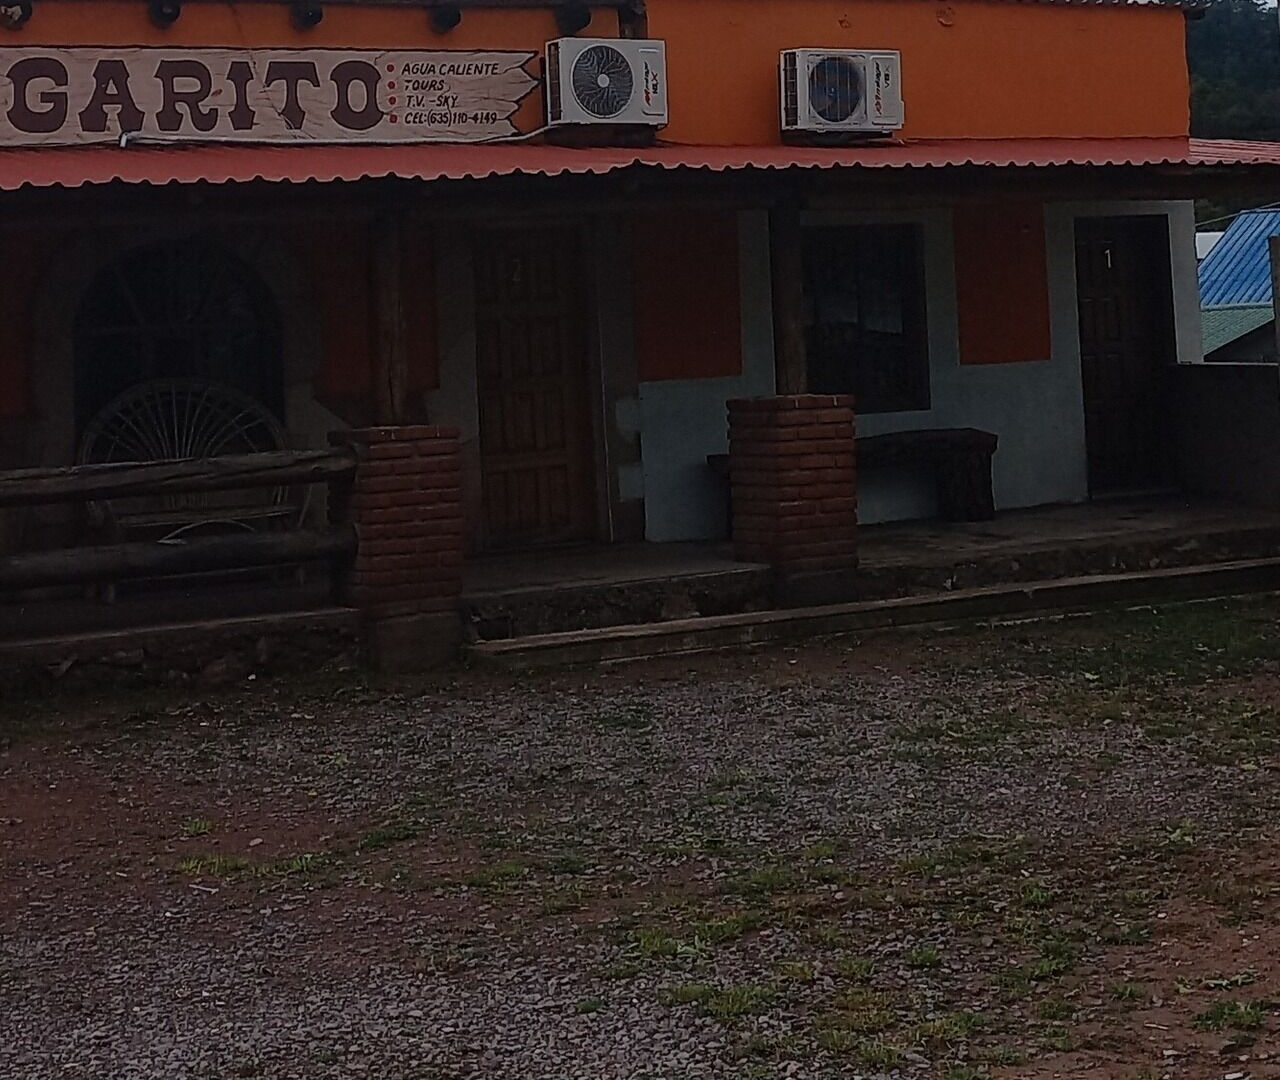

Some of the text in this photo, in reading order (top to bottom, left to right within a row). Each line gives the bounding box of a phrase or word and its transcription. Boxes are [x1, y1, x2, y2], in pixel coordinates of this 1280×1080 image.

[401, 62, 500, 76] AGUA CALIENTE
[404, 79, 445, 91] TOURS
[405, 95, 425, 108] T.V.
[1104, 248, 1111, 269] 1
[511, 258, 521, 282] 2
